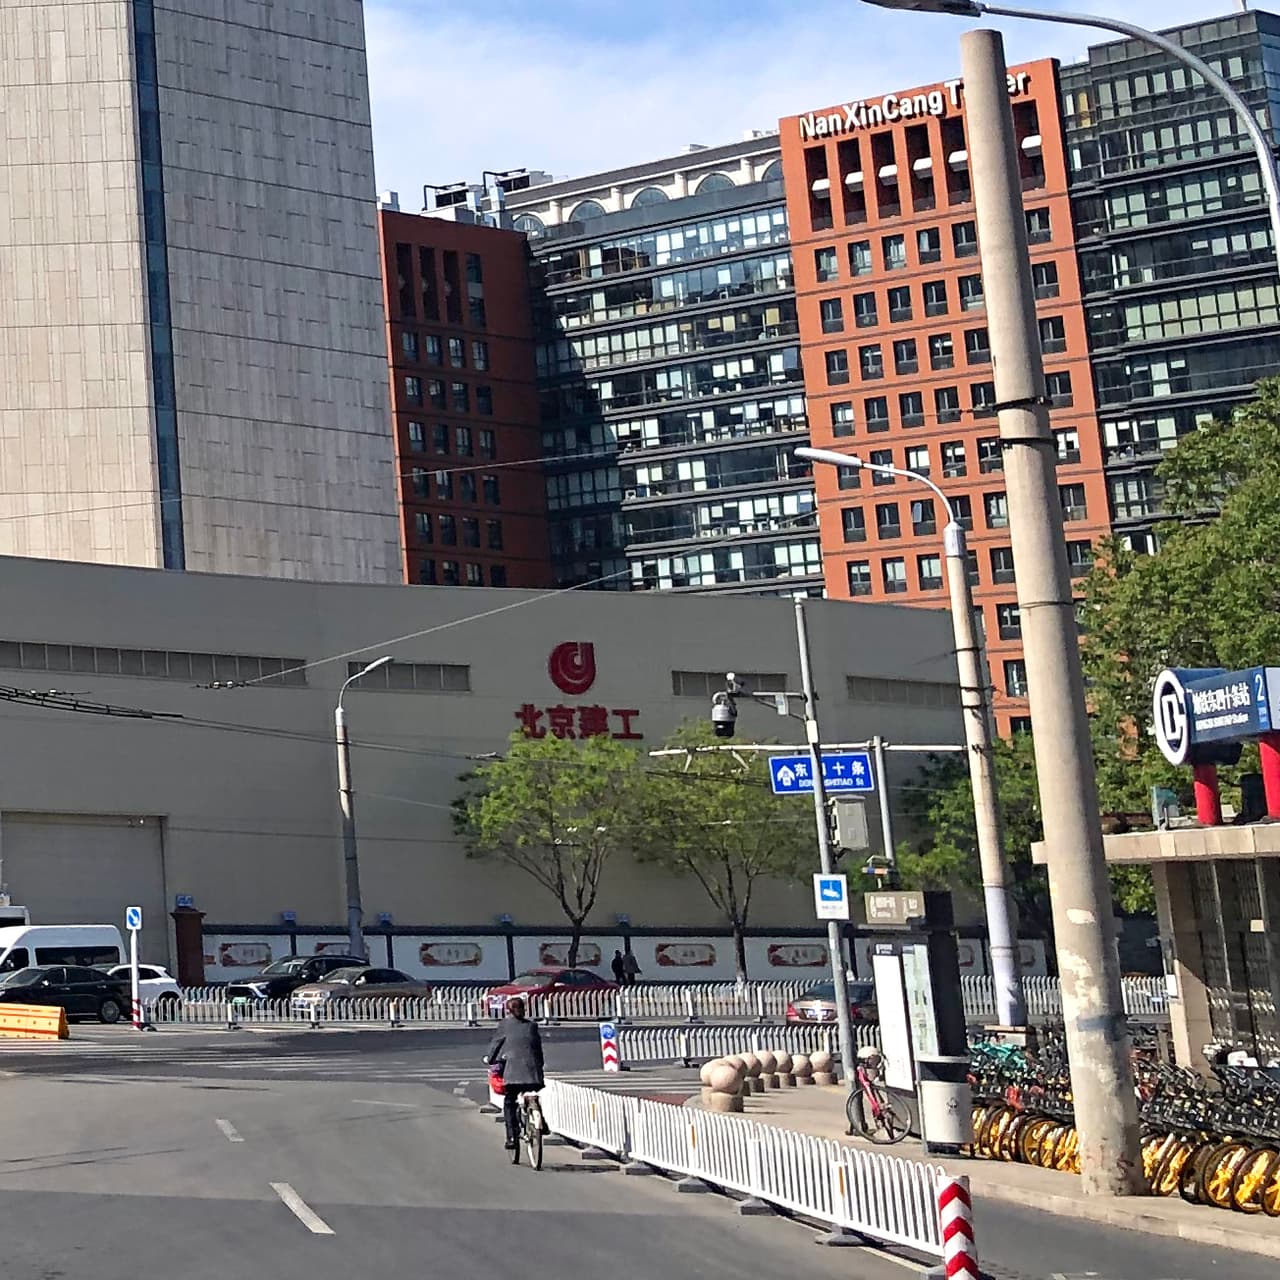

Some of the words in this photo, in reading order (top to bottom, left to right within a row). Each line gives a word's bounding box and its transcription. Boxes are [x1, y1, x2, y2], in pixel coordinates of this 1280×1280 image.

[799, 90, 943, 138] NanXinCang
[944, 71, 1028, 106] Ter
[1255, 674, 1265, 702] 2
[515, 704, 644, 740] 北京建工
[794, 760, 865, 777] 东十条
